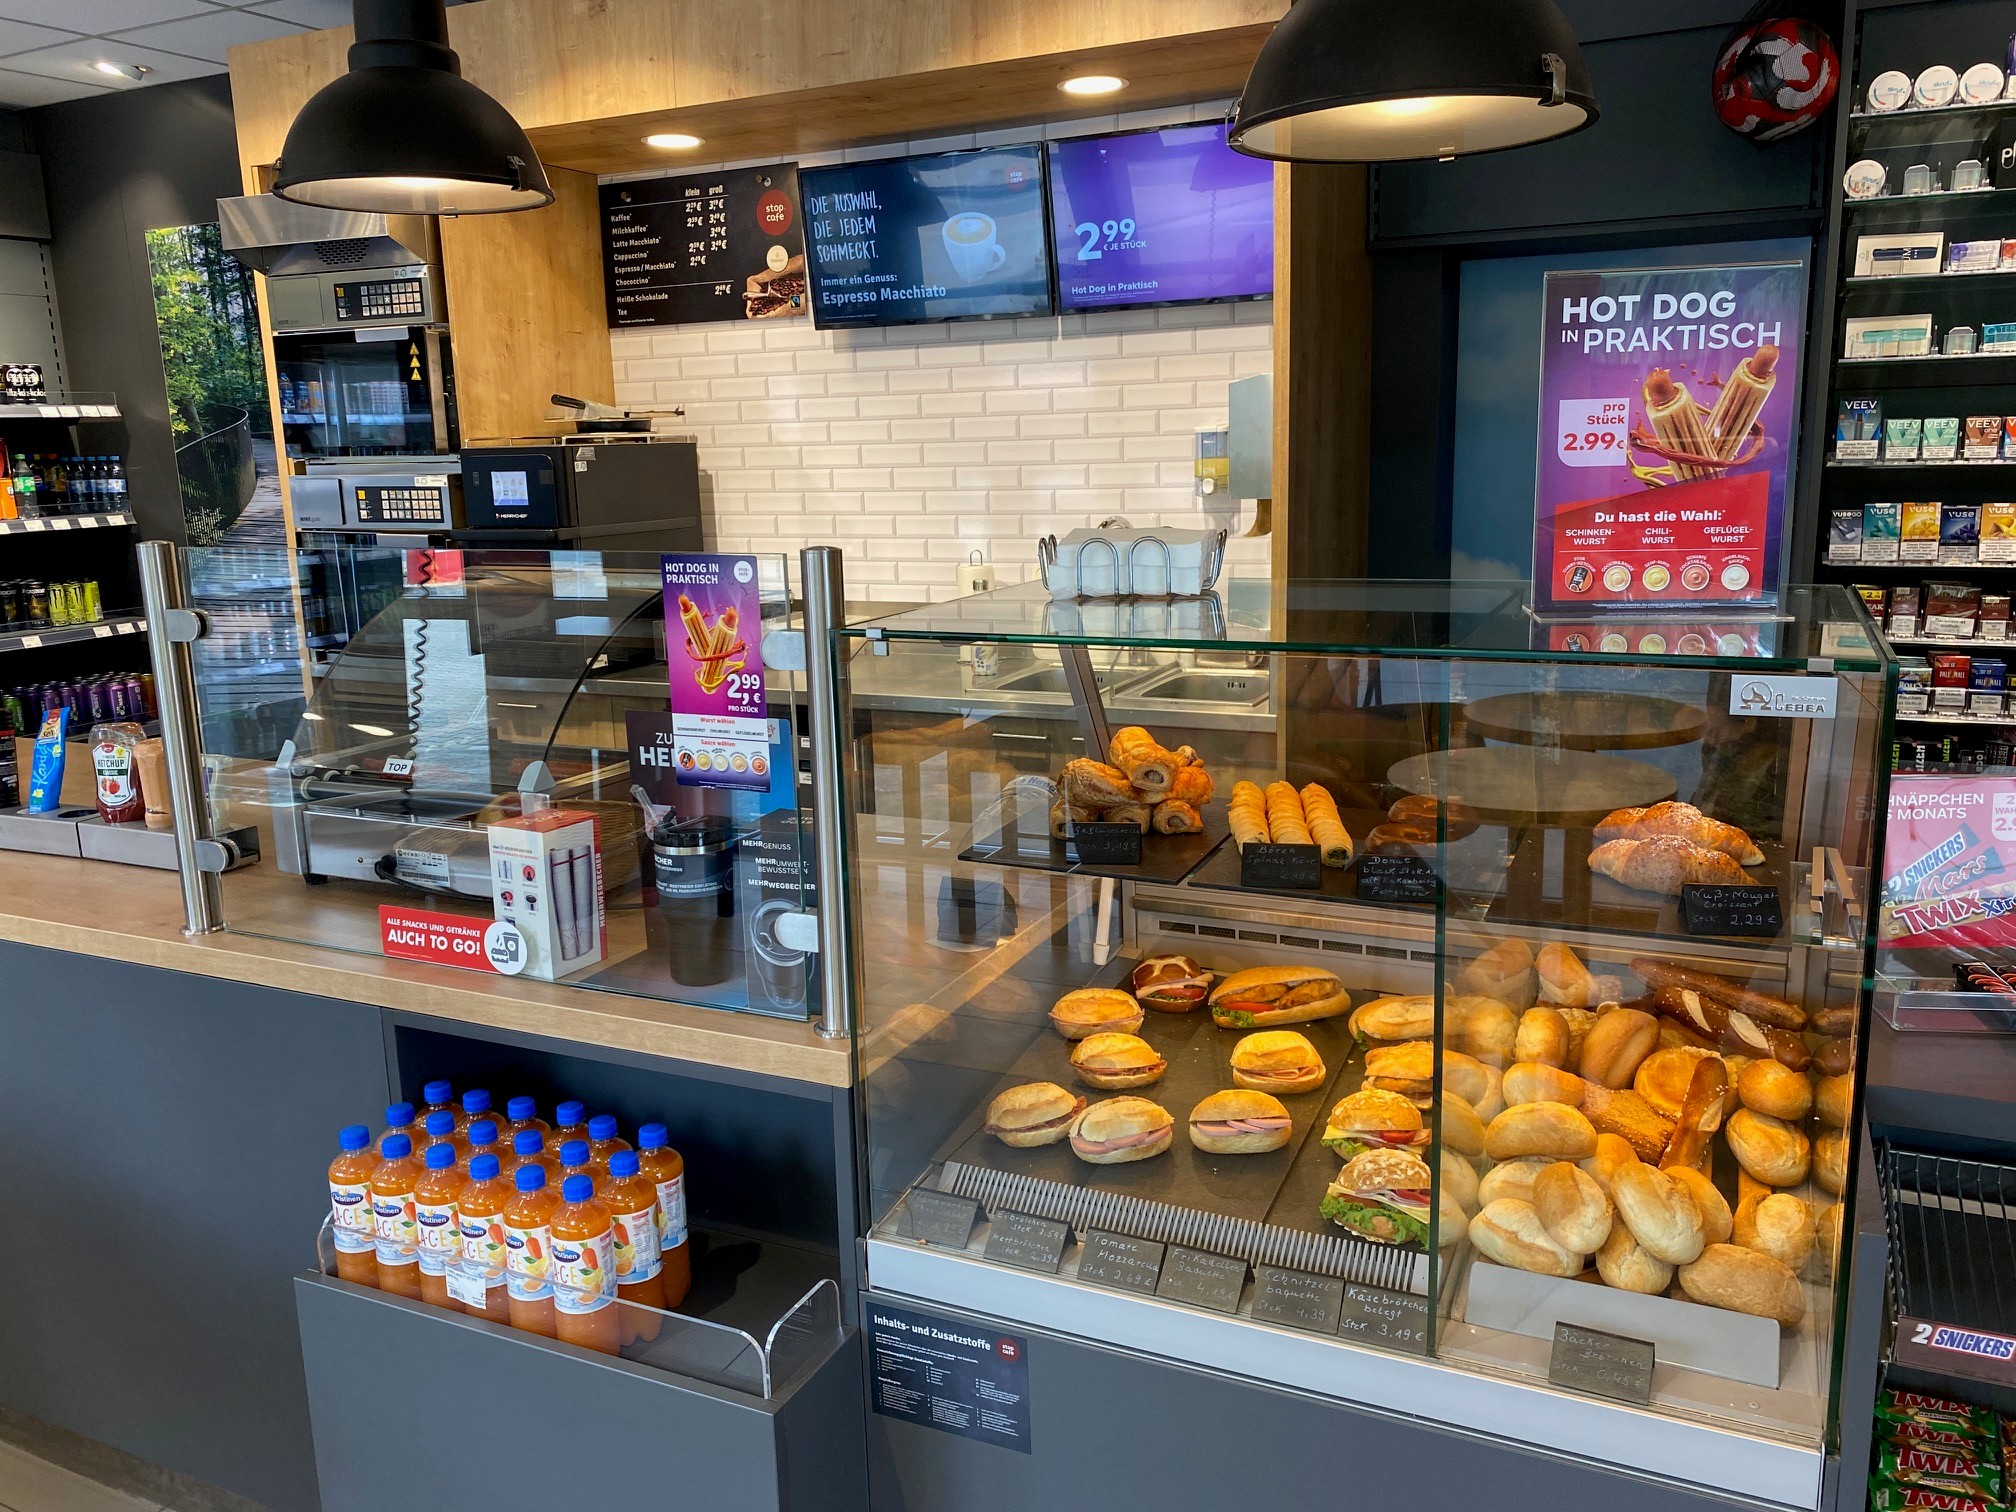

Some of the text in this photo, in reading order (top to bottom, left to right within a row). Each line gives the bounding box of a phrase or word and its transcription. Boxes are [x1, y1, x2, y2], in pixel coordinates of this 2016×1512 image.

[810, 190, 882, 216] DIE AUSWAHL,
[813, 215, 876, 240] DIE JEDEM
[612, 240, 628, 248] Latte
[1109, 243, 1119, 251] JE
[1120, 240, 1147, 250] STÜCK
[816, 240, 879, 263] SCHMECKT.
[614, 265, 640, 275] Espresso
[820, 273, 898, 287] Immer ein Genuss:
[1071, 280, 1159, 295] Hot Dog in Praktisch
[635, 293, 669, 302] Schokolade
[822, 285, 947, 307] Espresso Macchiato
[617, 308, 628, 316] Tee
[1562, 290, 1737, 324] HOT DOG
[1561, 321, 1782, 354] IN PRAKTISCH
[1603, 403, 1626, 415] pro
[1845, 400, 1877, 410] VEEV
[1586, 413, 1626, 426] Stück
[1889, 421, 1920, 429] VEEV
[1925, 420, 1957, 428] VEEV
[1967, 420, 2000, 428] VEEV
[1594, 510, 1677, 524] Du hast die
[1565, 524, 1754, 537] SCHINKEN- CHILI- GEFLÜGEL-
[1573, 534, 1745, 545] WURST WURST WURST
[665, 562, 719, 574] HOT DOG IN
[666, 574, 719, 585] PRAKTISCH
[740, 705, 759, 714] STÜCK
[387, 763, 408, 772] TOP
[1897, 807, 1967, 820] MONATS
[1367, 855, 1412, 866] Donut
[1904, 833, 1965, 884] SNICKERS
[757, 865, 809, 876] BEWUSSTSEN
[1914, 854, 1988, 901] Mars
[386, 917, 481, 938] ALLE SNACKS UND GETRÄNKE
[387, 928, 425, 947] AUCH
[429, 934, 448, 950] TO
[452, 939, 481, 956] GO!
[1093, 1232, 1138, 1252] Tomate
[1097, 1249, 1159, 1272] Mozzarella
[1363, 1304, 1403, 1321] belegt
[873, 1314, 910, 1331] Inhalts-
[911, 1323, 930, 1336] und
[931, 1328, 991, 1351] Zusatzstoffe
[1910, 1323, 2015, 1359] 2 SNICKERS
[1917, 1411, 1958, 1420] HAZELNUT
[1921, 1477, 1963, 1486] HAZELNUT
